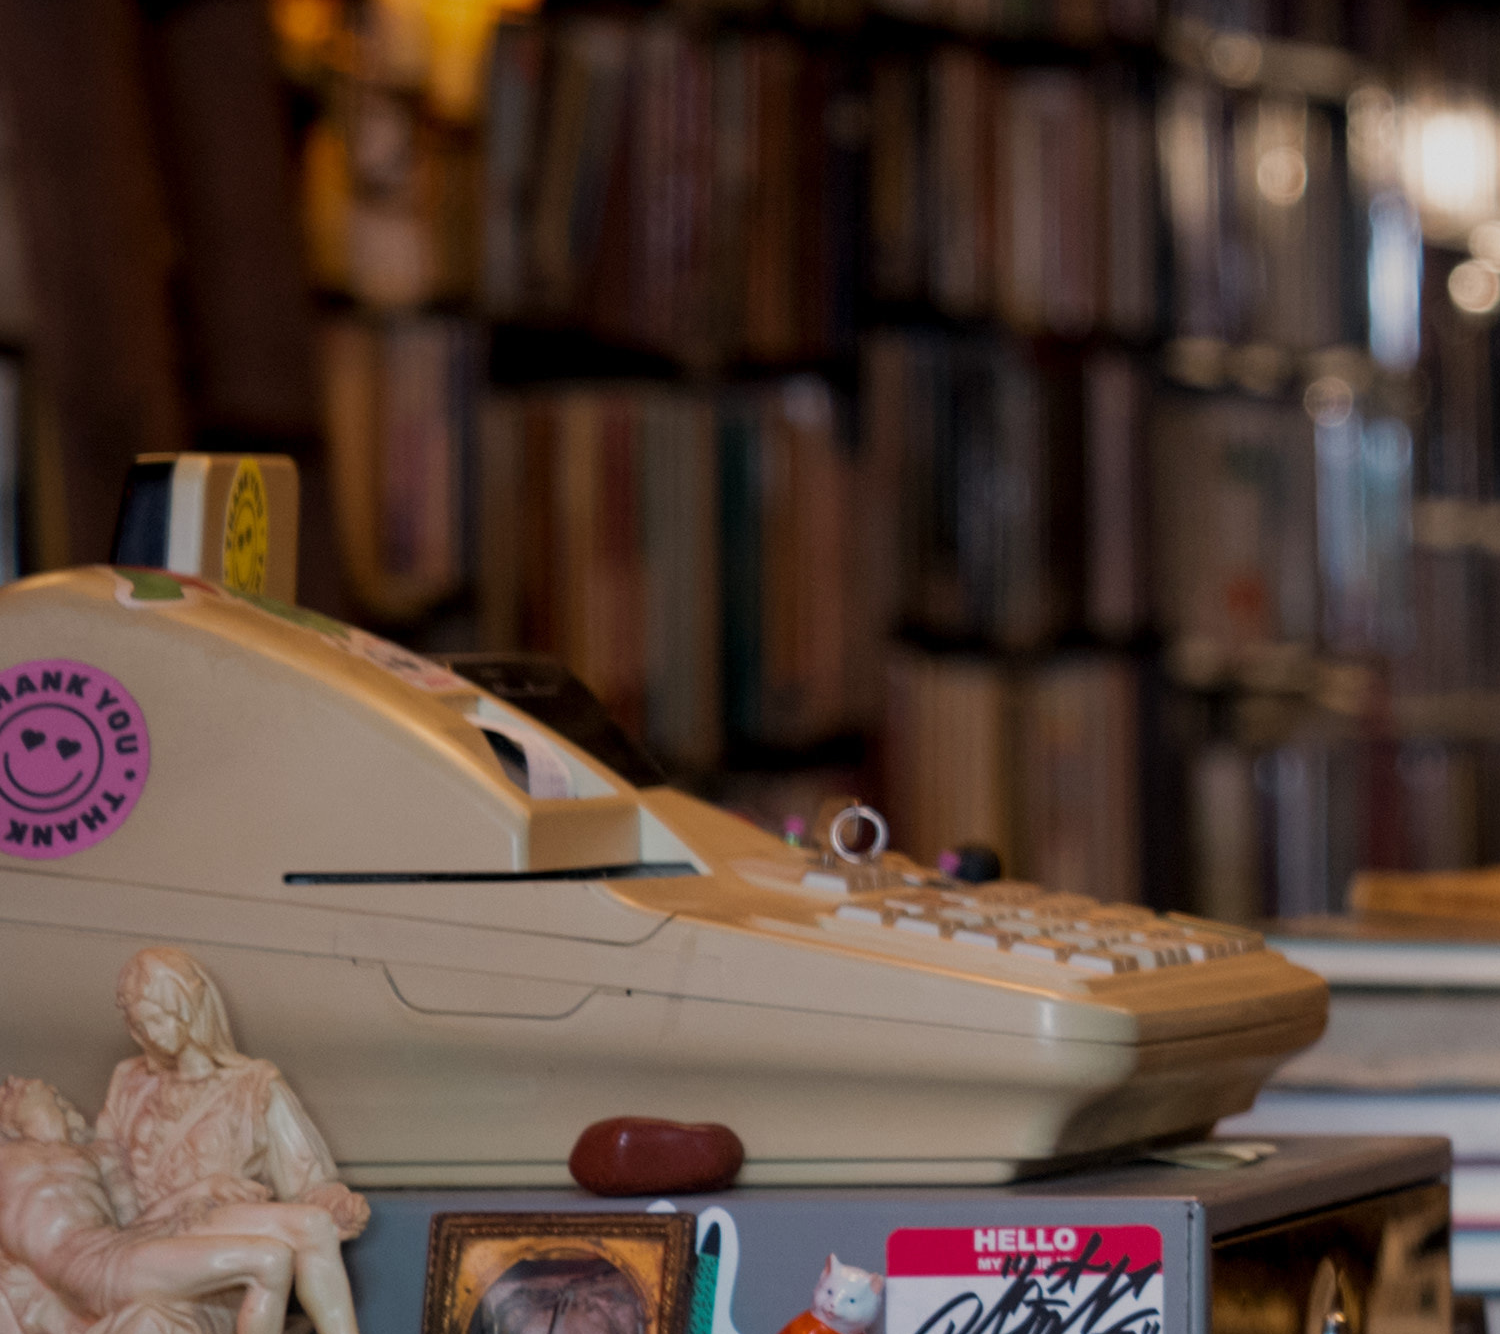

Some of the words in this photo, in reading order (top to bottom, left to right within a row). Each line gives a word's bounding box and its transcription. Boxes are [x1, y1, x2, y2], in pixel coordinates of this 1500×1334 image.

[96, 688, 139, 755] YOU
[4, 790, 126, 846] THANK
[974, 1228, 1078, 1253] HELLO
[978, 1257, 1001, 1271] MY
